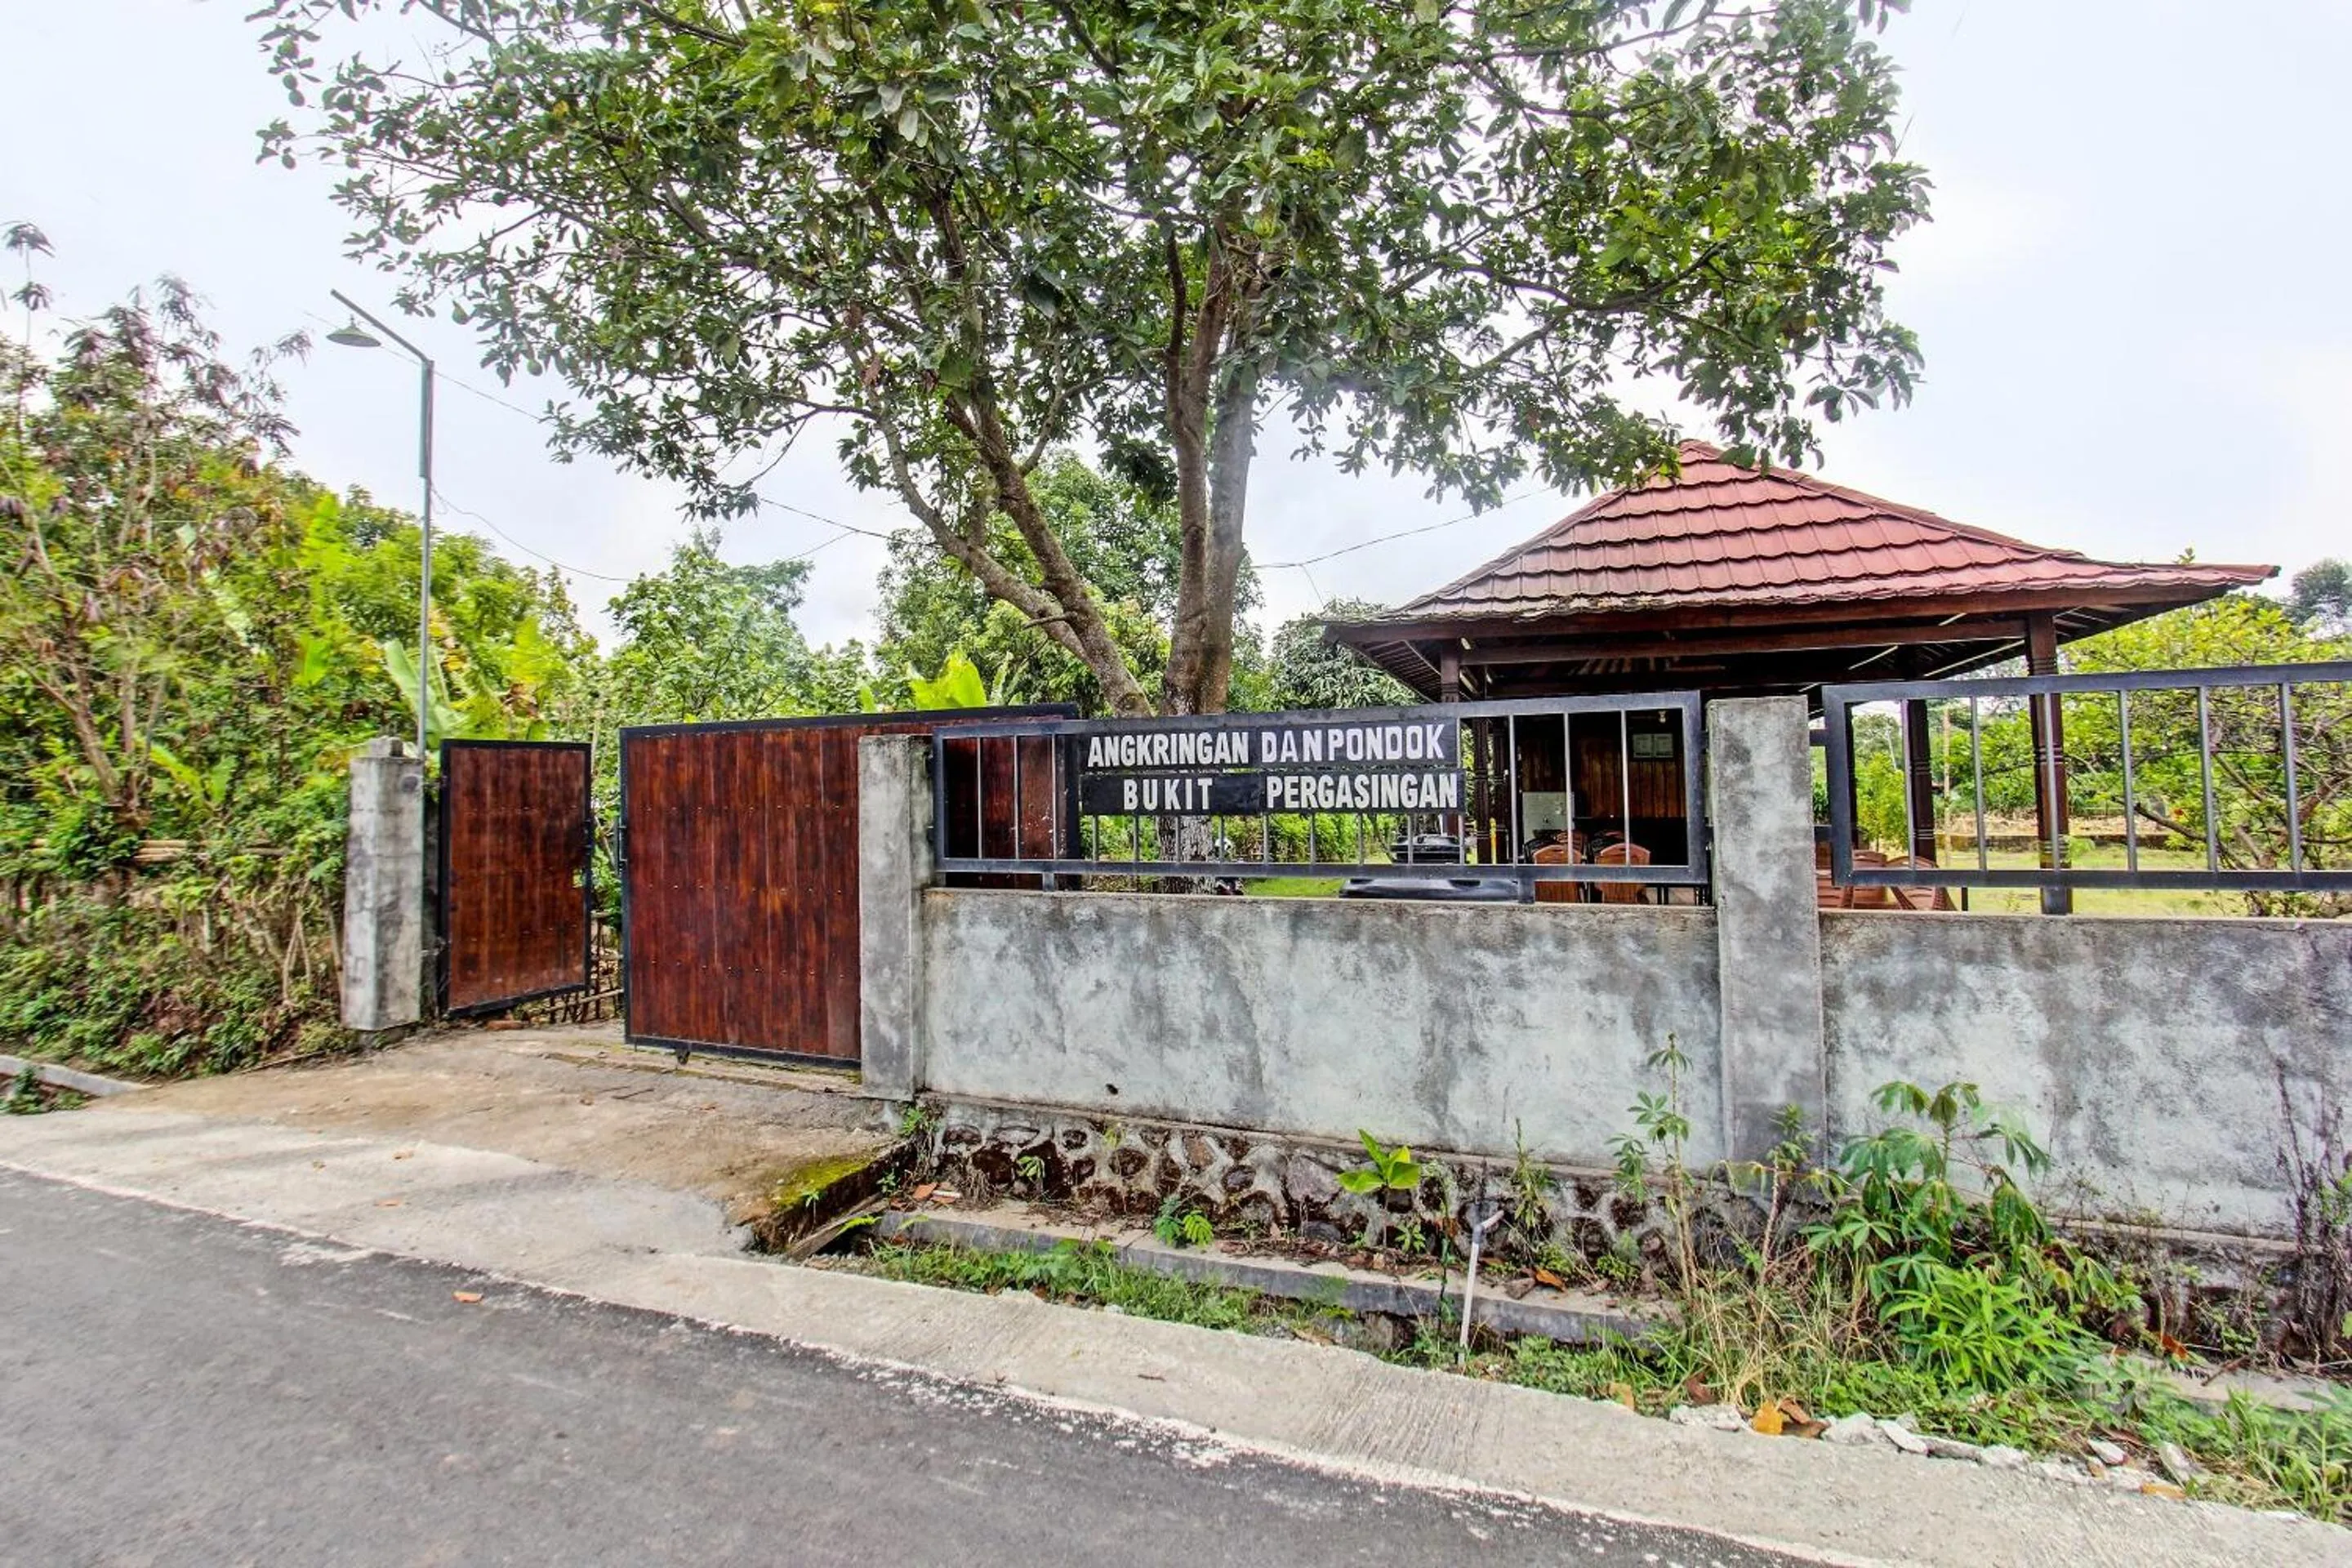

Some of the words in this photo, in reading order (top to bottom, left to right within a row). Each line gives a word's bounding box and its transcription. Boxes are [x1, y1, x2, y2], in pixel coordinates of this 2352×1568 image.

[1087, 732, 1249, 768] ANGKRINGAN
[1261, 729, 1323, 763] DAN
[1328, 724, 1445, 761] PONDOK
[1123, 777, 1214, 811] BUKIT
[1267, 773, 1457, 809] PERGASINGAN
